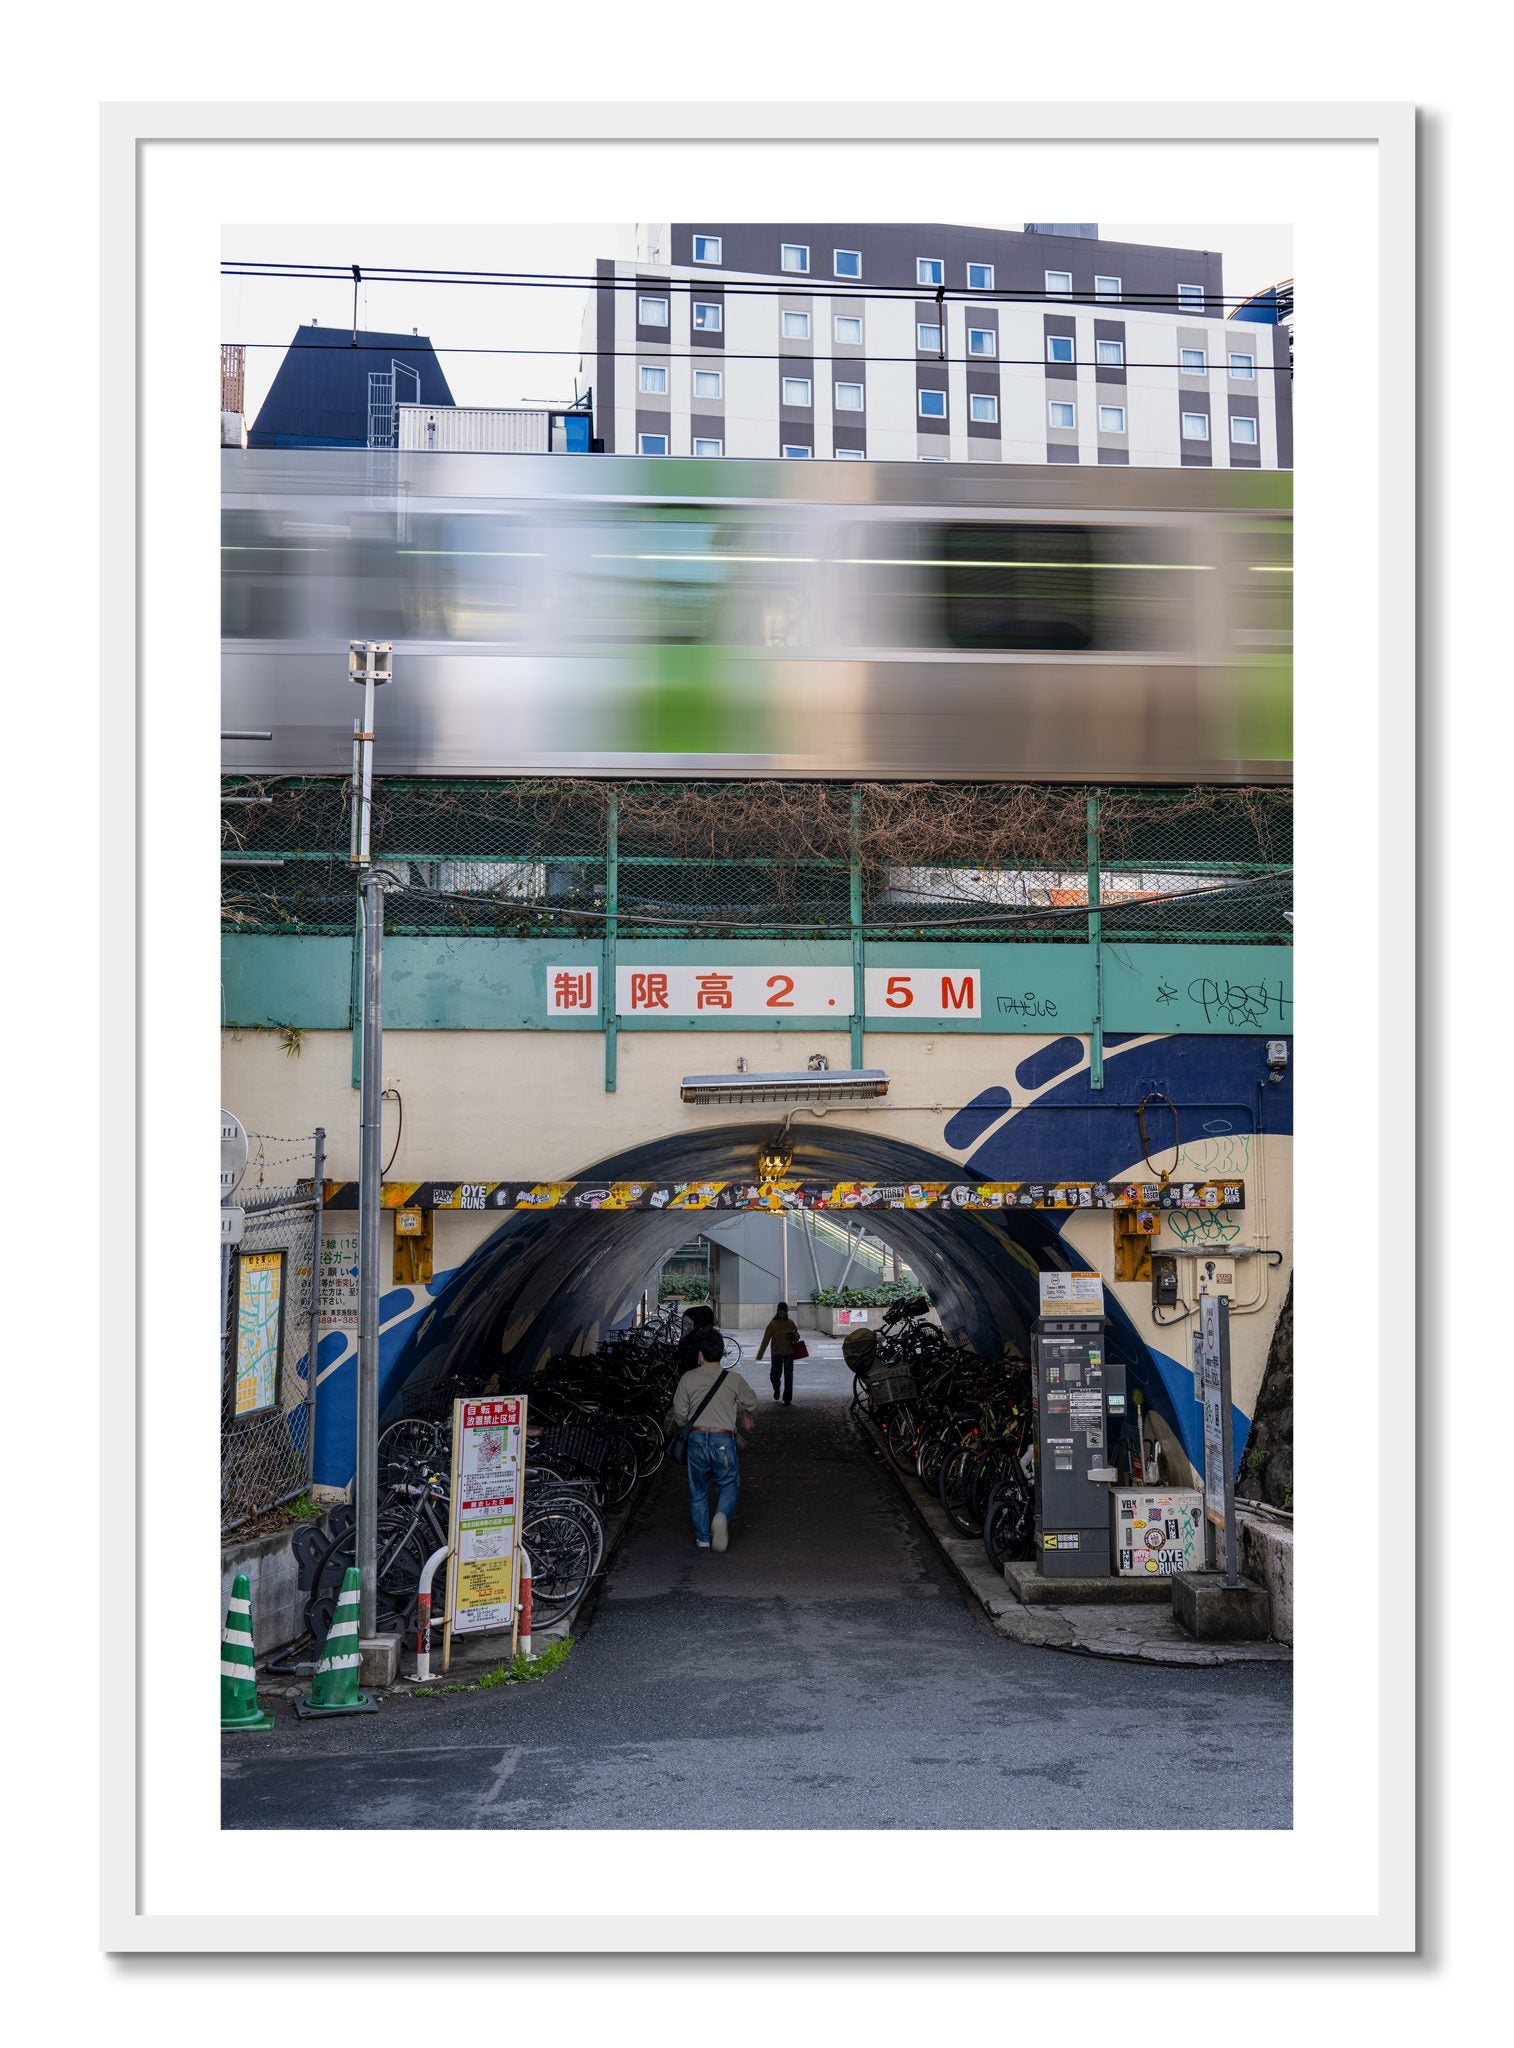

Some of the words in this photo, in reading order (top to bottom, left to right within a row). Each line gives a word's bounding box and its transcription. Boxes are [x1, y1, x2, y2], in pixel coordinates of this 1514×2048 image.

[462, 1184, 487, 1197] OYE
[1224, 1187, 1240, 1195] OYE
[461, 1197, 486, 1209] RUNS
[1224, 1194, 1240, 1203] RUNS
[466, 1413, 517, 1427] 放置禁止区域
[1159, 1550, 1182, 1562] OYE
[1160, 1562, 1183, 1575] RUNS
